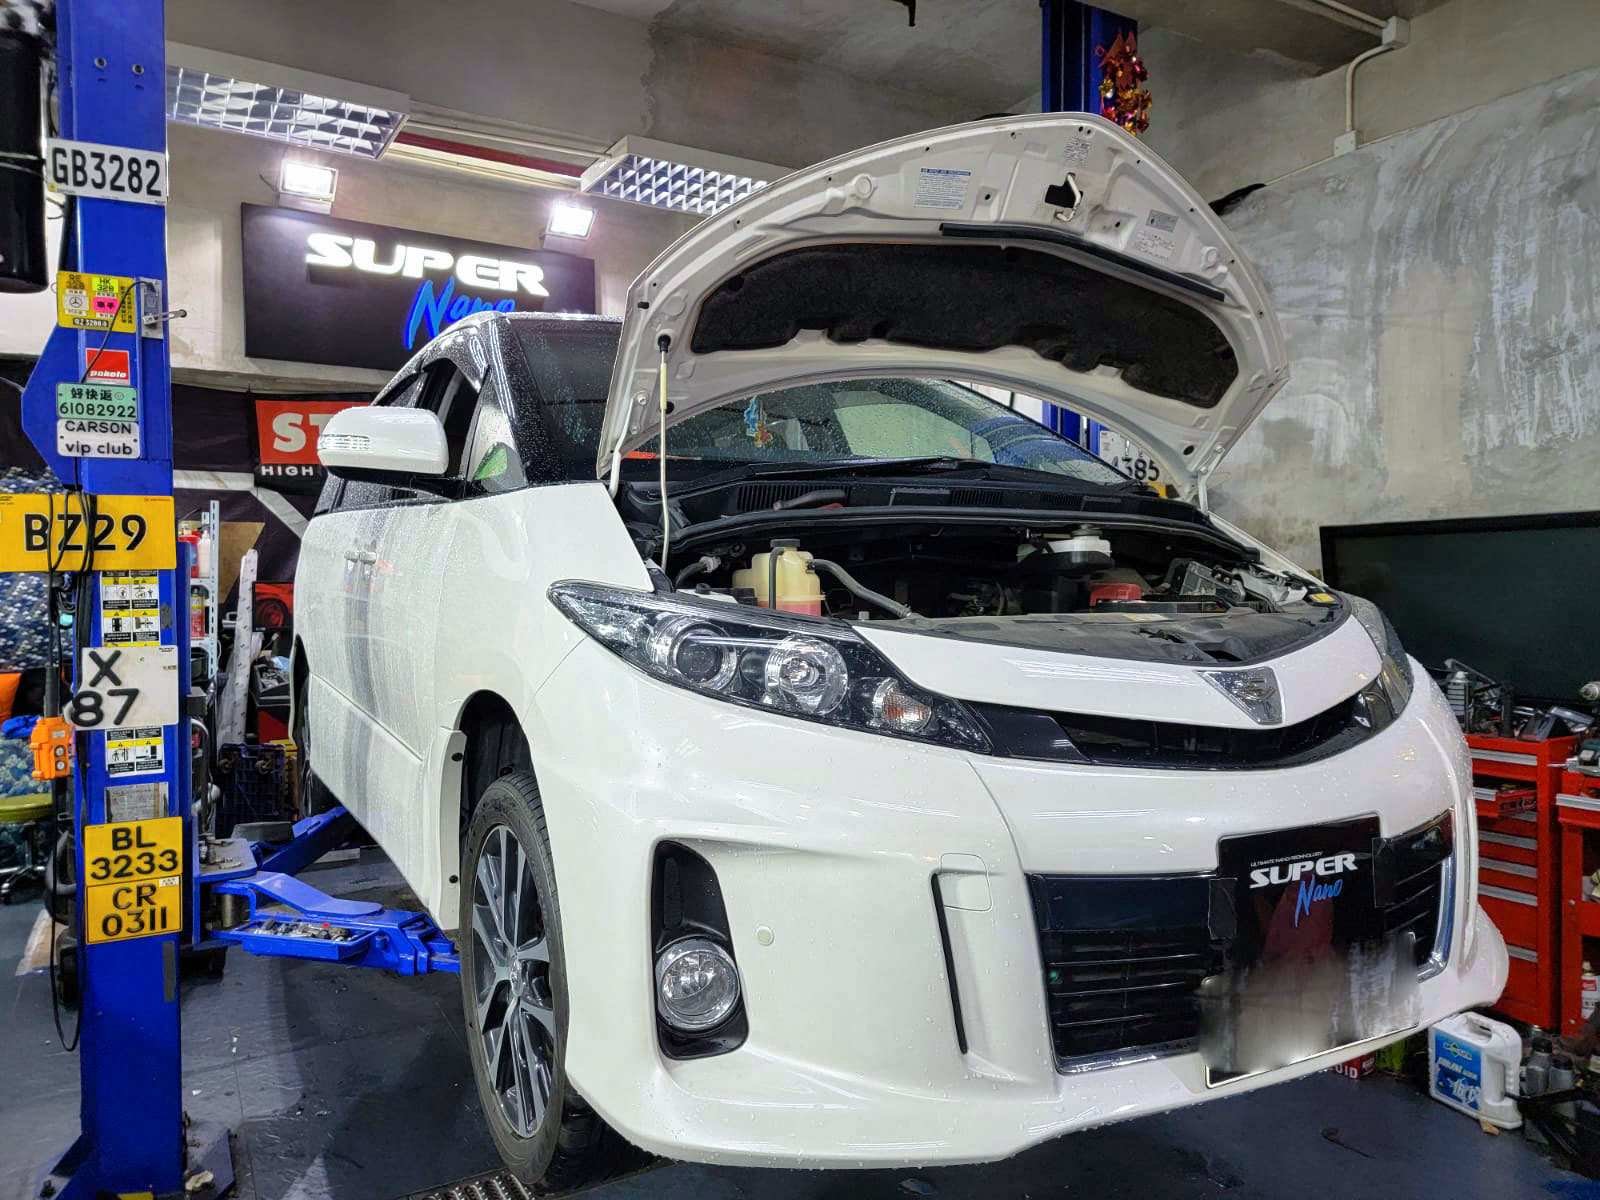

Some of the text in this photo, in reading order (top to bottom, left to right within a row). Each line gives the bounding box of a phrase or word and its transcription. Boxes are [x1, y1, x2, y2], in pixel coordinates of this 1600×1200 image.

[52, 147, 162, 197] GB3282
[305, 232, 550, 297] SUPER
[71, 387, 113, 401] 好快返
[60, 402, 136, 418] 61082922
[65, 420, 132, 434] CARSON
[65, 440, 133, 456] vip club
[261, 465, 314, 476] HIGH
[24, 513, 147, 552] BZ29
[88, 650, 122, 687] X
[71, 688, 139, 728] 87
[112, 826, 157, 851] BL
[90, 849, 179, 880] 3233
[1249, 853, 1359, 889] SUPER
[112, 883, 157, 909] CR
[1295, 874, 1343, 928] Nano
[102, 906, 168, 937] 0311
